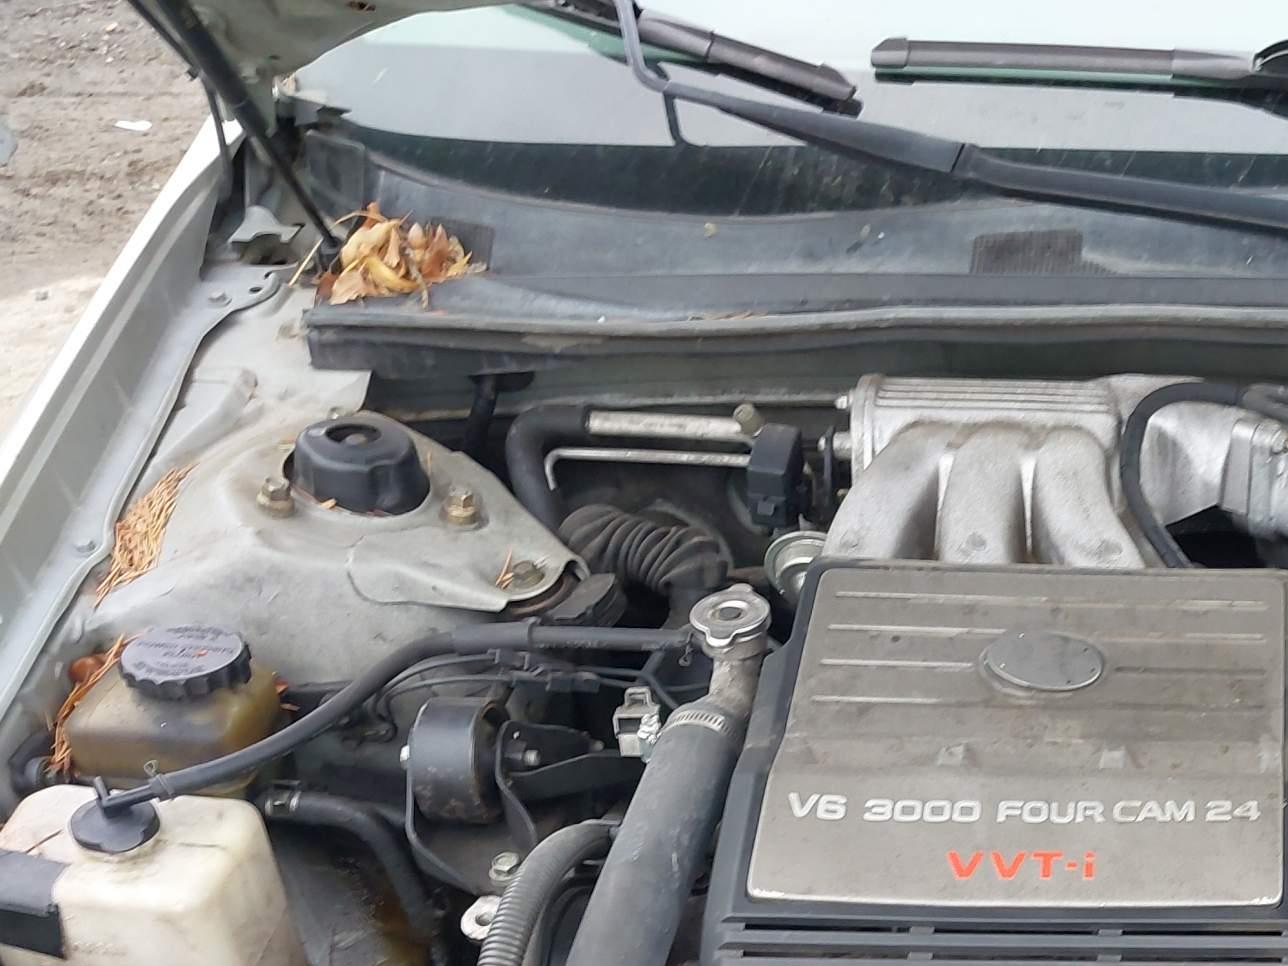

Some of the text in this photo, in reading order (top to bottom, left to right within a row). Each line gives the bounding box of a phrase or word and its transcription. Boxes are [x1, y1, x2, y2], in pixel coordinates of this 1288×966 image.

[788, 793, 1261, 825] V6 3000 FOUR CAM 24
[946, 850, 1098, 881] VVT-i
